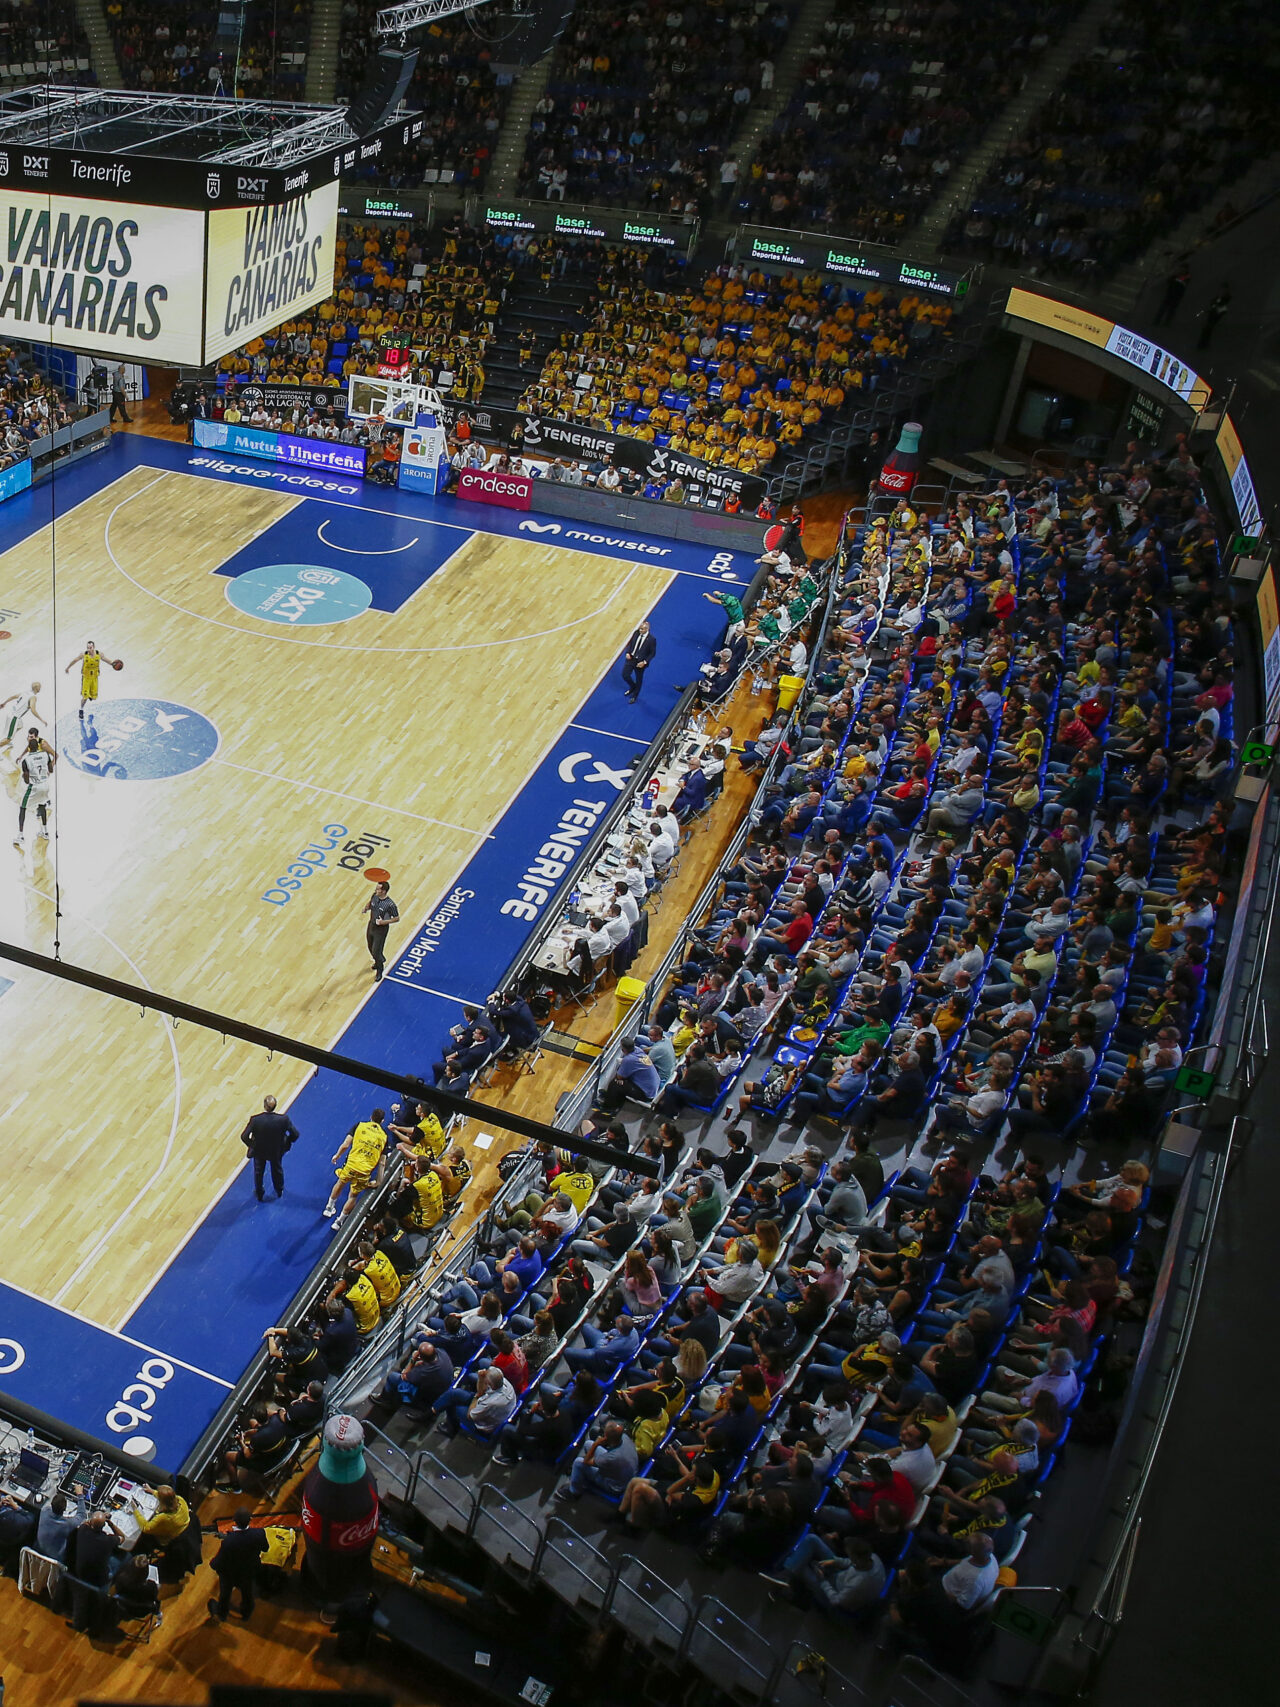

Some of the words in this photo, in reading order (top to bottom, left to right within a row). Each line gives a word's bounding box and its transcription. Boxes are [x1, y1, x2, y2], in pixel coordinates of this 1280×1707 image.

[360, 139, 382, 159] Tenerife
[23, 155, 49, 169] DXT
[23, 169, 49, 178] TENERIFE
[71, 159, 132, 187] Tenerife
[237, 177, 269, 192] DXT
[284, 170, 309, 192] Tenerife
[237, 192, 265, 200] TENERIFE
[365, 209, 390, 217] Deportes
[392, 210, 413, 218] Natalia
[515, 221, 535, 229] Natalia
[243, 192, 312, 269] VAMOS
[555, 225, 583, 236] Deportes
[584, 229, 605, 237] Natalia
[623, 233, 651, 243] Deportes
[652, 236, 675, 245] Natalia
[8, 207, 138, 278] VAMOS
[751, 250, 781, 261] Deportes
[782, 255, 805, 265] Natalia
[826, 262, 855, 273] Deportes
[857, 267, 880, 277] Natalia
[224, 235, 322, 336] CANARIAS
[899, 275, 928, 286] Deportes
[929, 281, 951, 293] Natalia
[386, 349, 399, 364] 18
[277, 400, 311, 408] LAGNA
[543, 426, 615, 454] TENERIFE
[234, 435, 284, 454] Mutua
[288, 445, 363, 469] Tinerfeña
[188, 457, 359, 495] #ligaendesa
[461, 474, 529, 498] endesa
[670, 460, 743, 492] TENERIFE
[565, 530, 672, 556] movistar
[273, 587, 325, 622] DXT
[649, 783, 659, 794] 5
[337, 832, 391, 872] liga
[500, 799, 606, 922] TENERIFE
[261, 823, 349, 907] endesa
[425, 887, 475, 937] Santiago
[395, 936, 440, 978] Martín
[1186, 1074, 1203, 1088] P
[106, 1358, 174, 1432] acb
